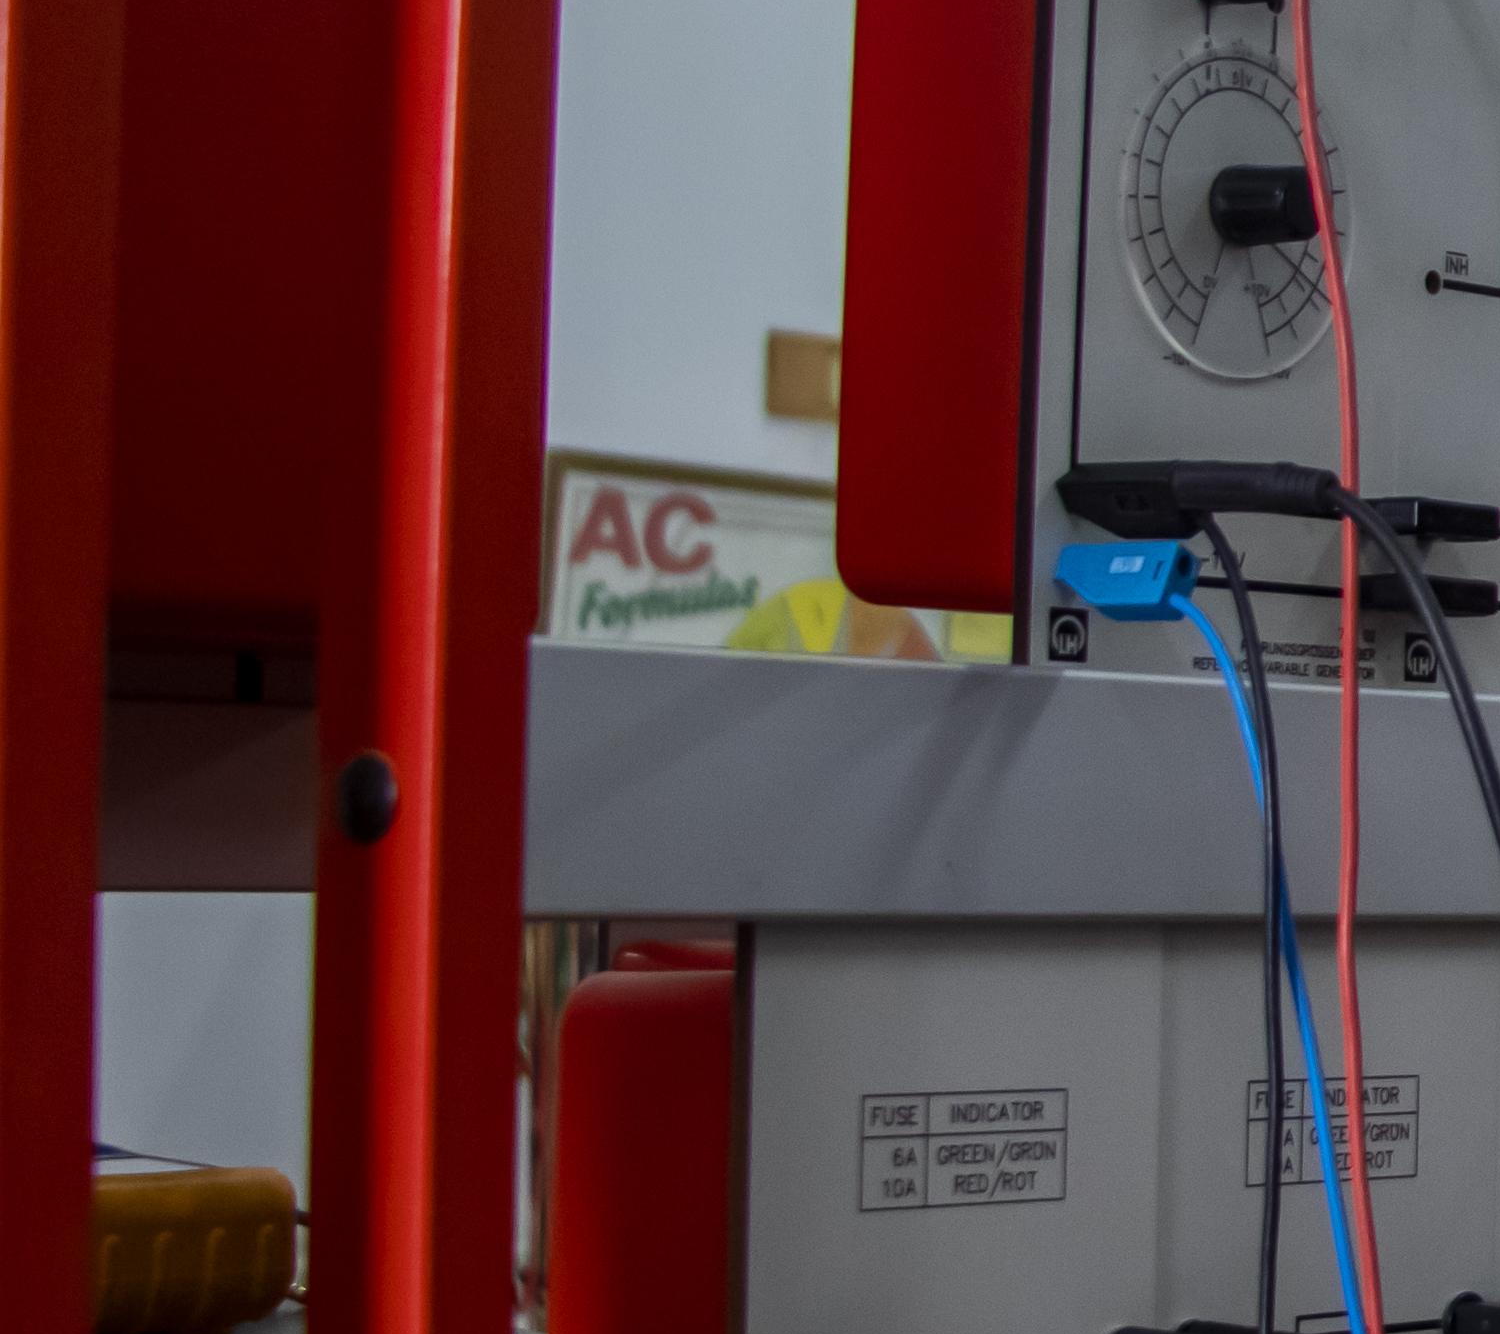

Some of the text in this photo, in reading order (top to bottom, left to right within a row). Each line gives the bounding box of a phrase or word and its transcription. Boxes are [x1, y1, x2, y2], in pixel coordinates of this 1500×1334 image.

[1445, 255, 1469, 277] INH
[569, 488, 717, 573] AC
[579, 577, 758, 630] Formulas
[1255, 1088, 1296, 1111] FE
[870, 1100, 1045, 1129] FUSE INDICATOR
[891, 1147, 918, 1169] 6A
[882, 1169, 1038, 1200] 10A RED/ROT
